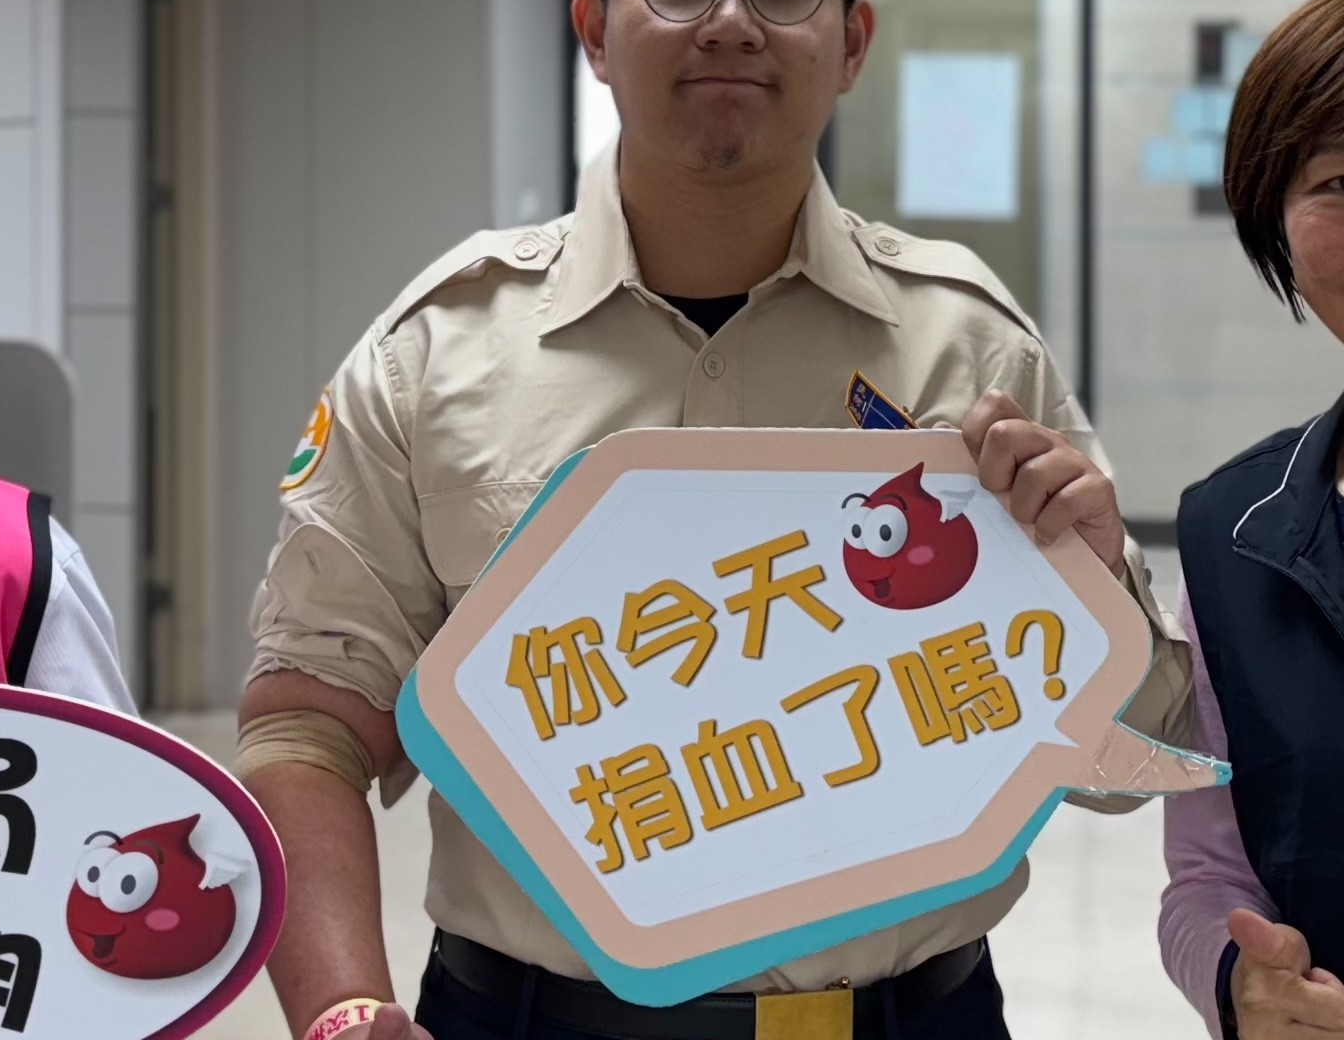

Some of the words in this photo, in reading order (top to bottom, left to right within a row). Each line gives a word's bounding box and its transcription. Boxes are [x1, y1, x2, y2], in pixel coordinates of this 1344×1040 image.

[505, 529, 844, 741] 你今天
[568, 609, 1067, 874] 捐血了嗎?
